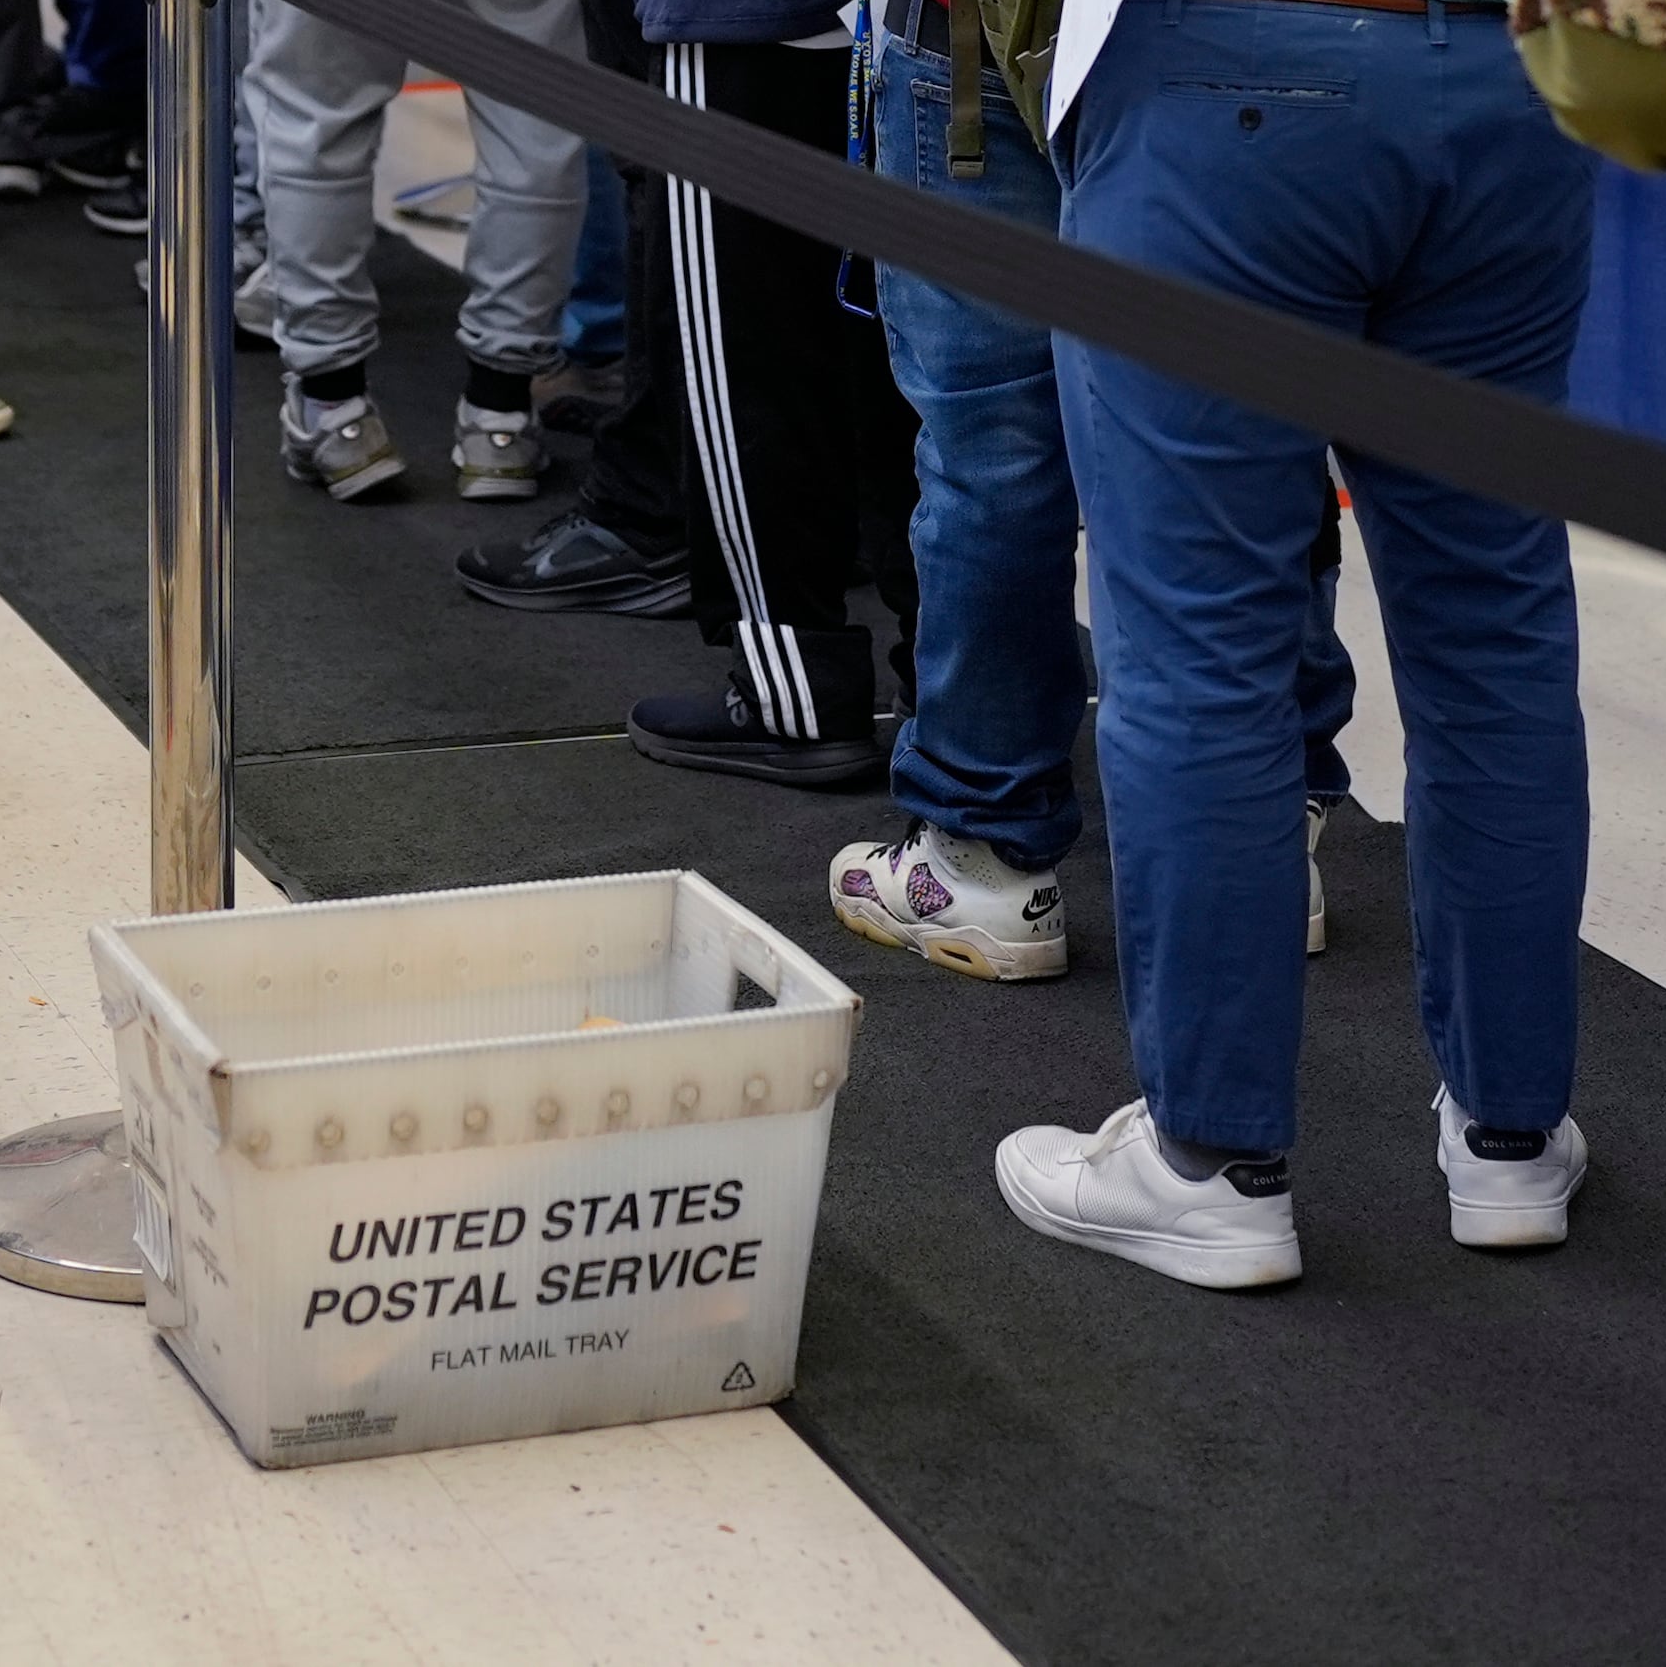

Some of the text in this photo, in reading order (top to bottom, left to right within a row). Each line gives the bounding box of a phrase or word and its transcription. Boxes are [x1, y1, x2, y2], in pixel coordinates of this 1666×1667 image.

[327, 1179, 744, 1265] UNITED STATES
[303, 1239, 763, 1330] POSTAL SERVICE
[431, 1329, 631, 1372] FLAT MAIL TRAY
